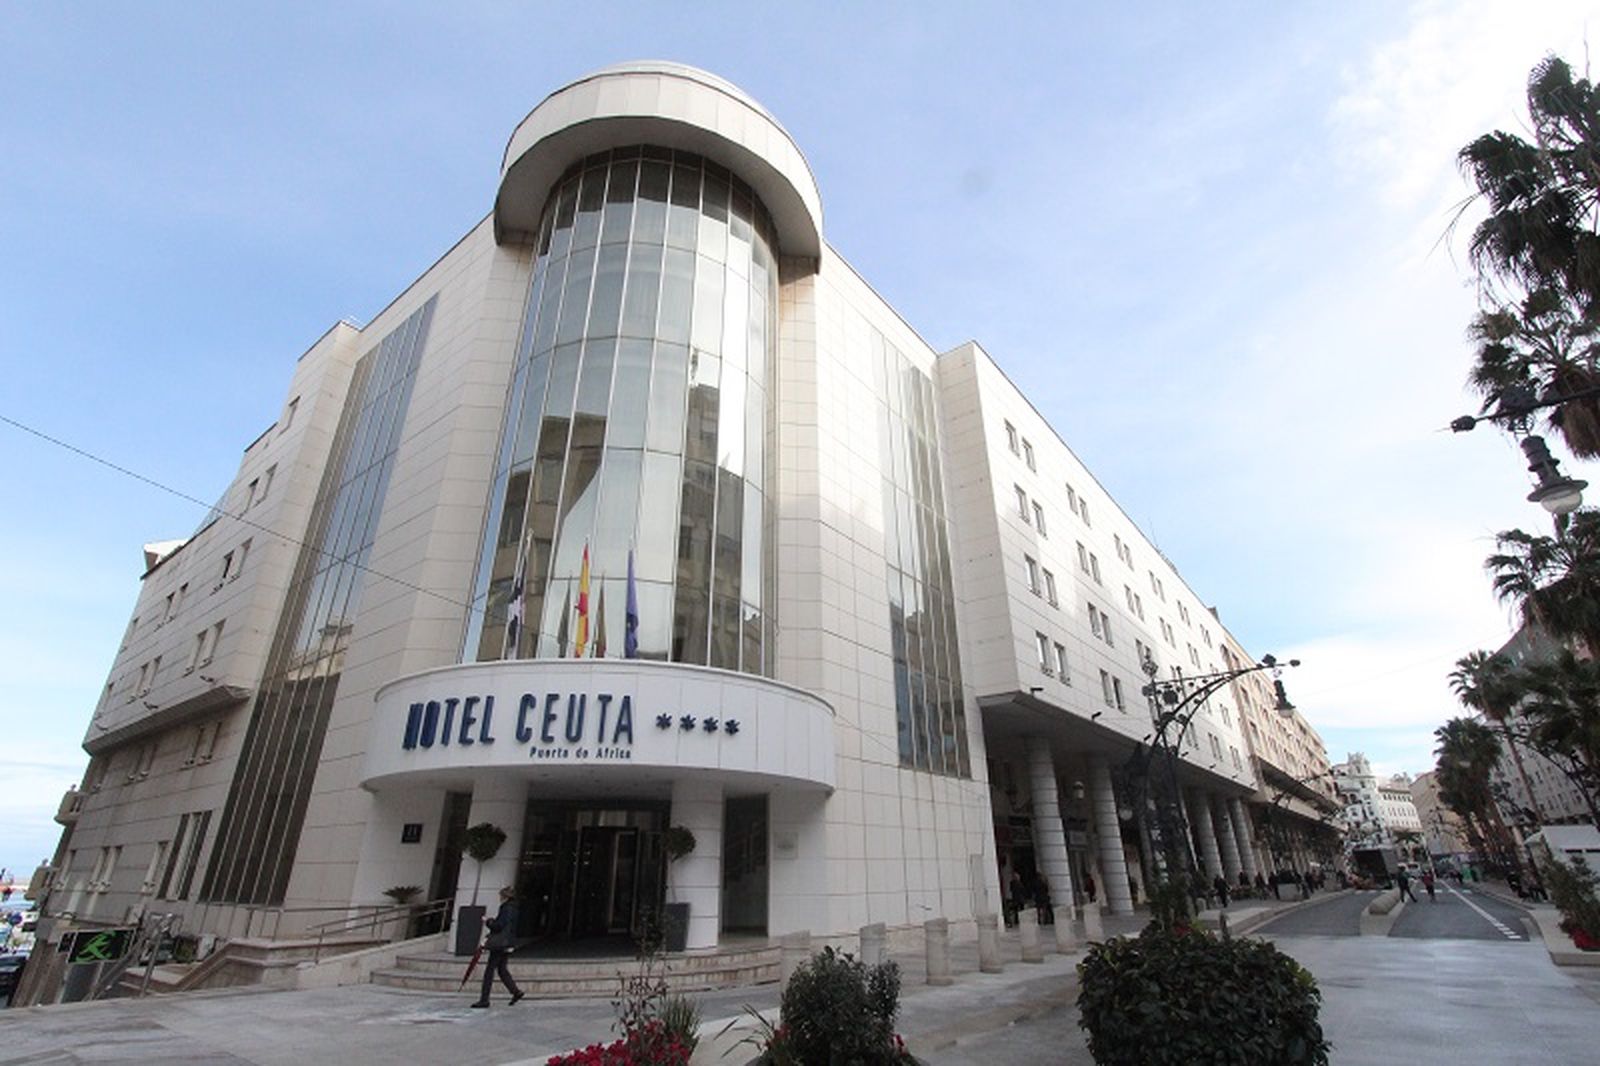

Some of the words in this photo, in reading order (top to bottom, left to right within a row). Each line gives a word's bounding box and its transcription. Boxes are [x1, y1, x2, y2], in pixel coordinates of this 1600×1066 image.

[402, 695, 496, 751] HOTEL
[515, 693, 633, 745] CEUTA
[529, 746, 568, 759] Puerta
[576, 747, 588, 759] de
